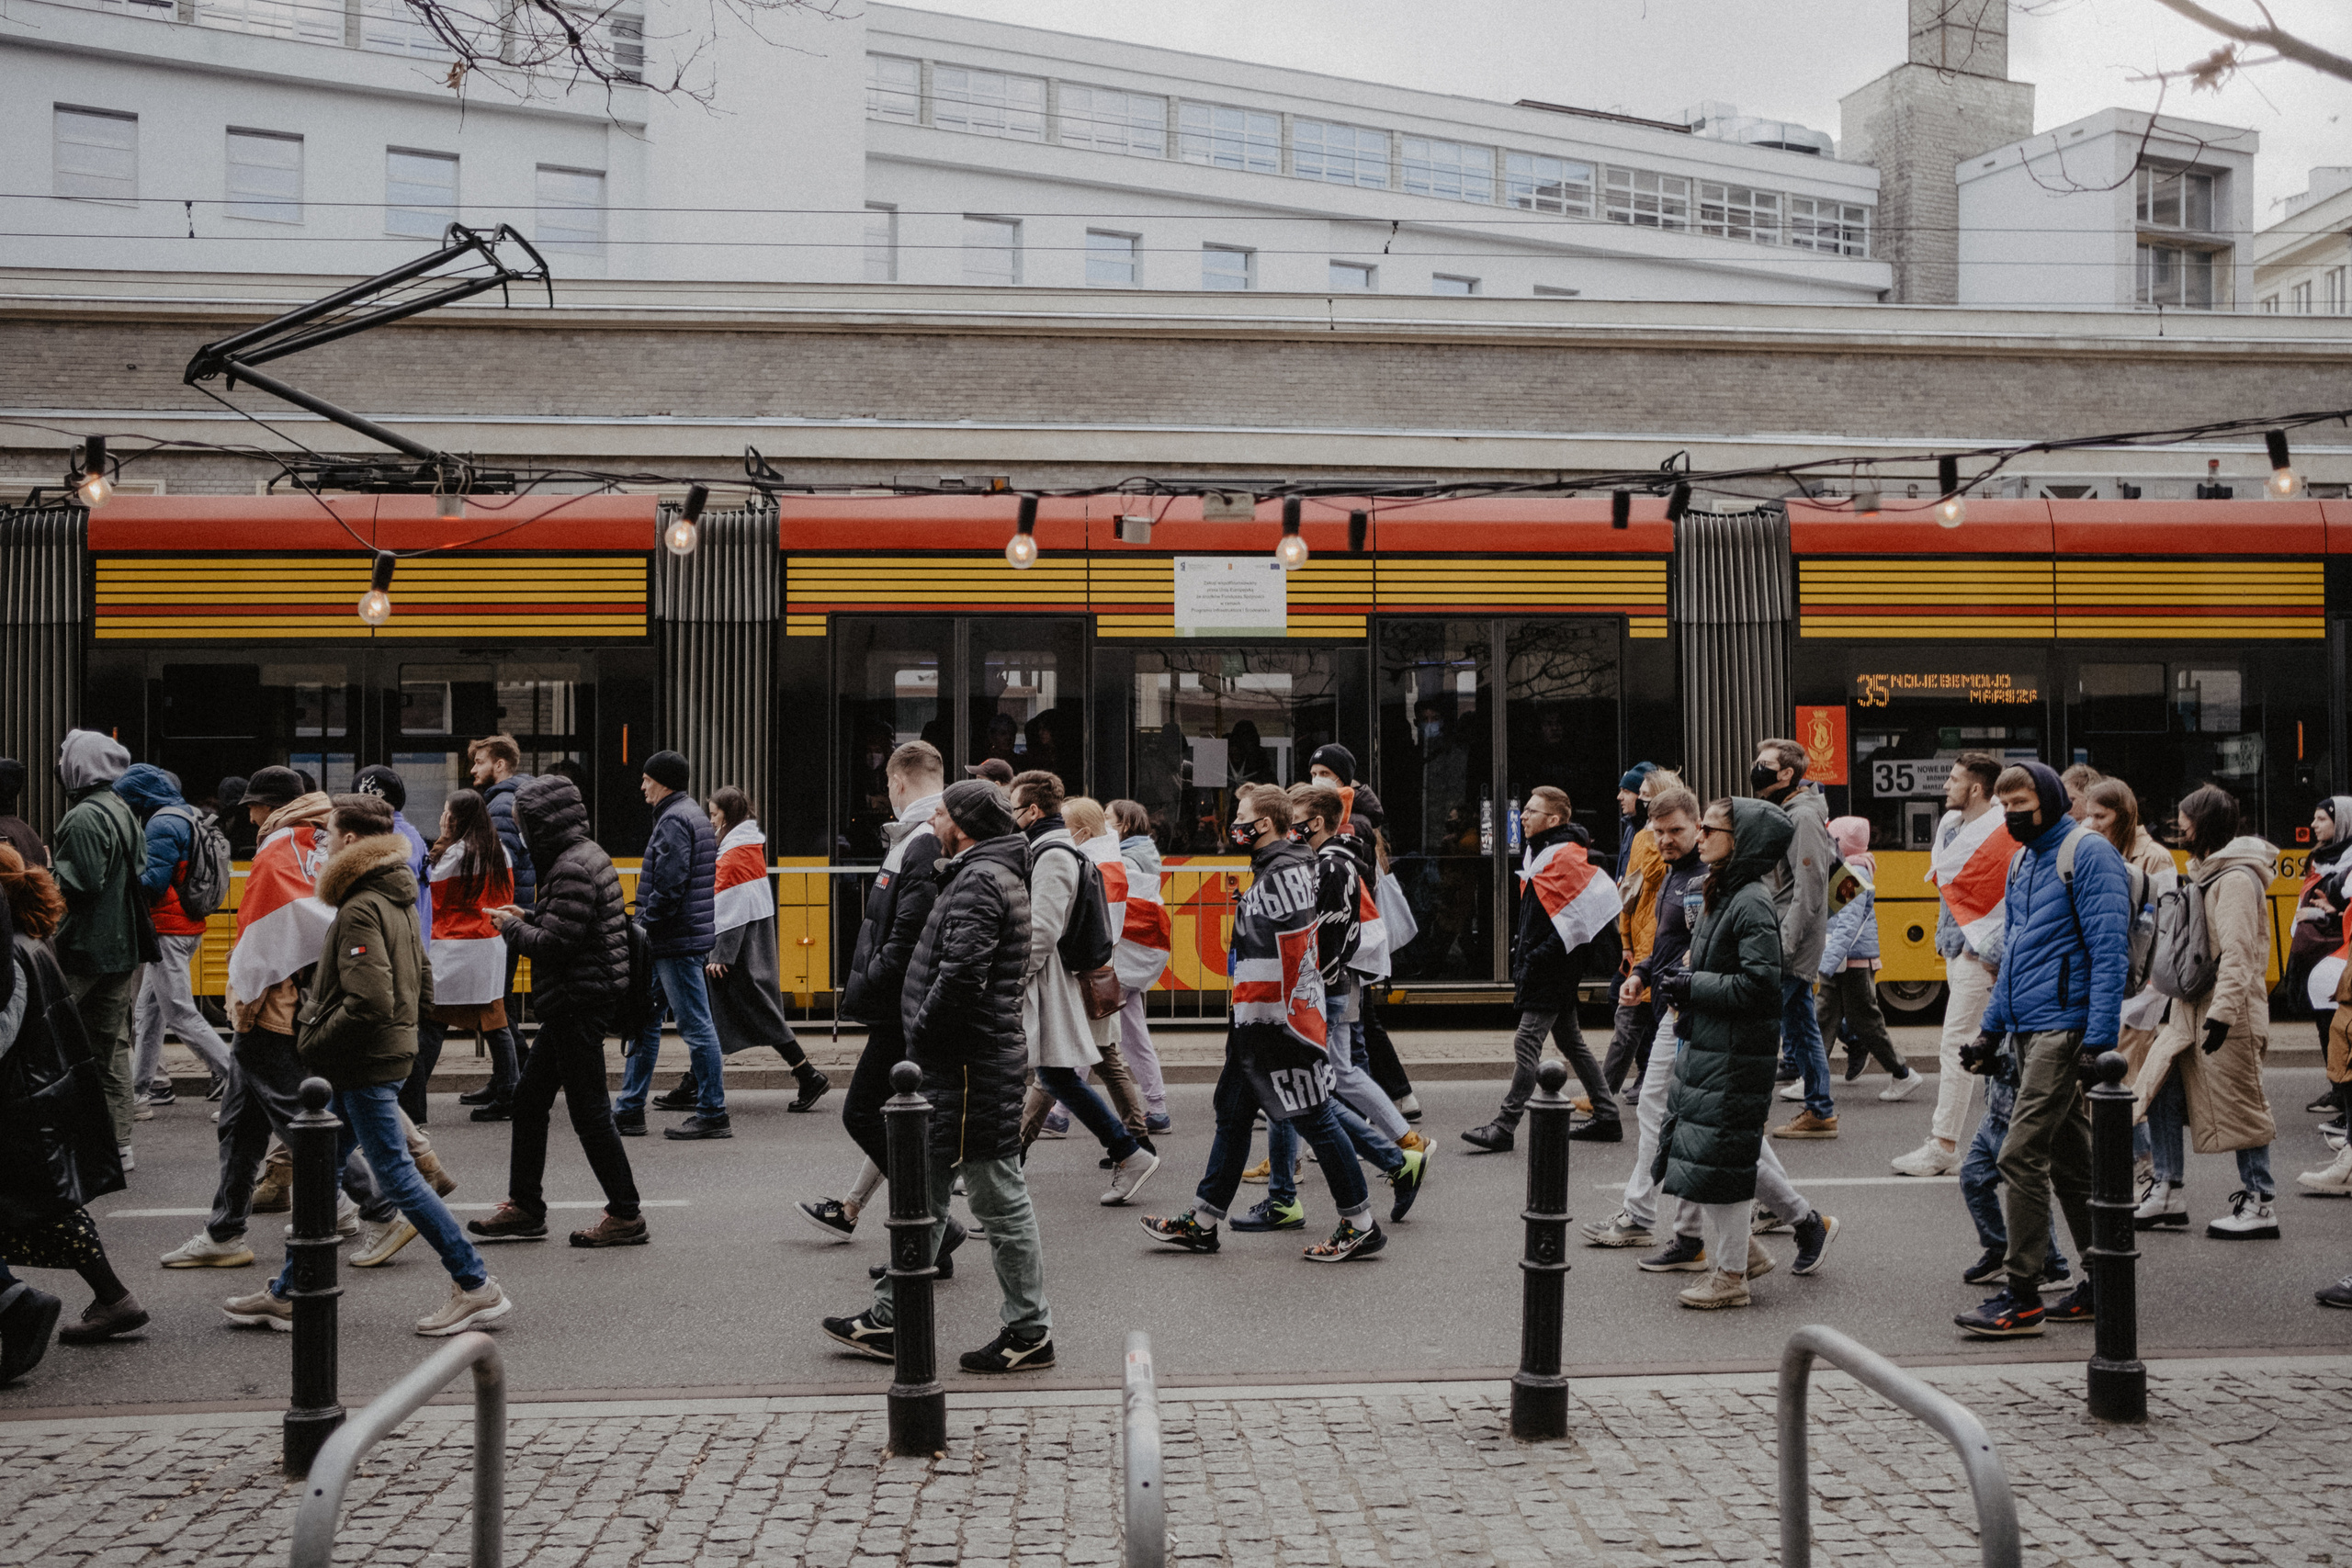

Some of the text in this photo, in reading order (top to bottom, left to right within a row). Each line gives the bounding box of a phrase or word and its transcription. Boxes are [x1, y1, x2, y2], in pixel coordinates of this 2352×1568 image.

[1857, 674, 2011, 707] 35 NOWE BEMOWO
[1875, 764, 1915, 793] 35
[1917, 765, 1939, 773] NOWE
